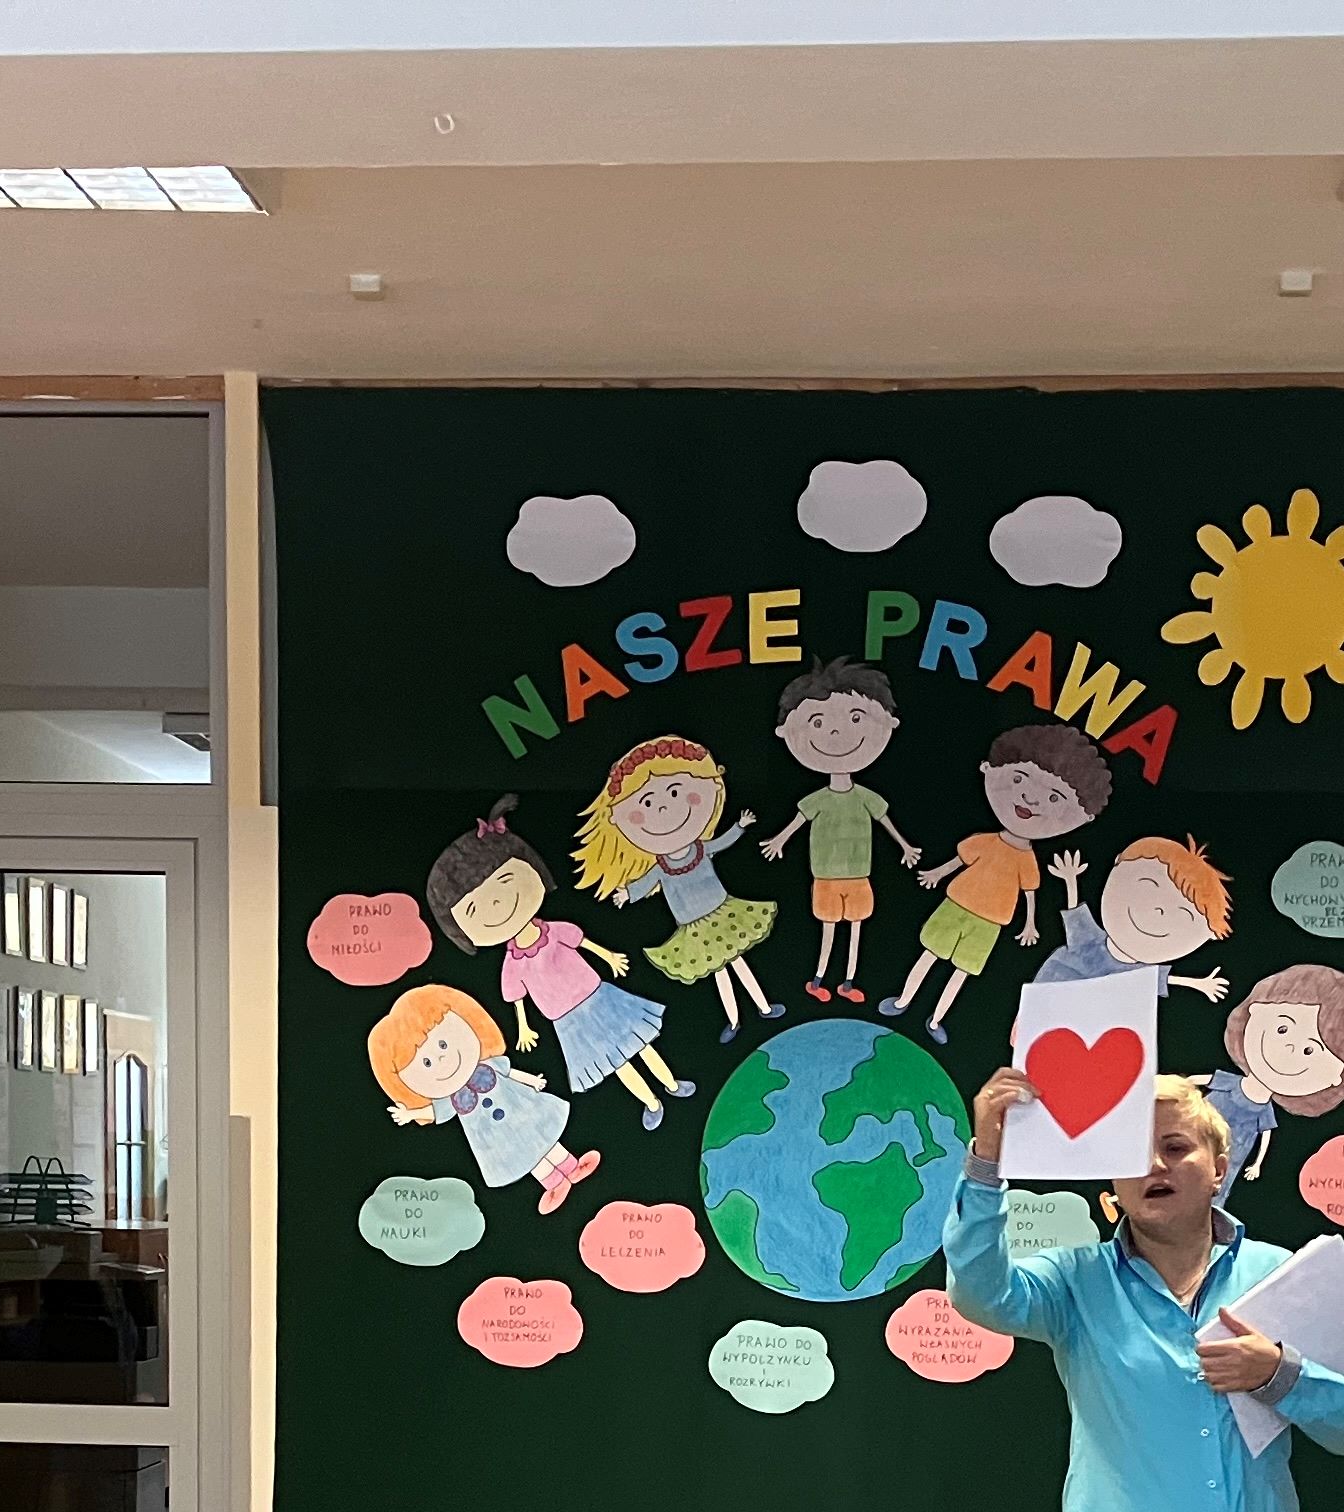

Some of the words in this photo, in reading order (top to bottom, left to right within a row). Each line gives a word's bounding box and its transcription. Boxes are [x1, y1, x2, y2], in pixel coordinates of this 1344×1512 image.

[482, 588, 802, 760] NASZE
[864, 590, 1178, 785] PRAWA
[1321, 876, 1338, 888] DO
[350, 904, 392, 918] PRAWO
[353, 924, 369, 935] DO
[394, 1190, 439, 1201] PRAWO
[405, 1208, 423, 1218] DO
[622, 1213, 662, 1223] PRAWO
[1017, 1222, 1034, 1230] DO
[380, 1227, 426, 1239] NAUKI
[629, 1230, 644, 1239] DO
[504, 1287, 542, 1298] PRAWO
[927, 1297, 950, 1308] PRA
[510, 1306, 526, 1315] DO
[934, 1313, 950, 1322] DO
[737, 1335, 787, 1348] PRAWO
[796, 1339, 811, 1350] DO
[730, 1377, 790, 1388] ROZRYWKI
